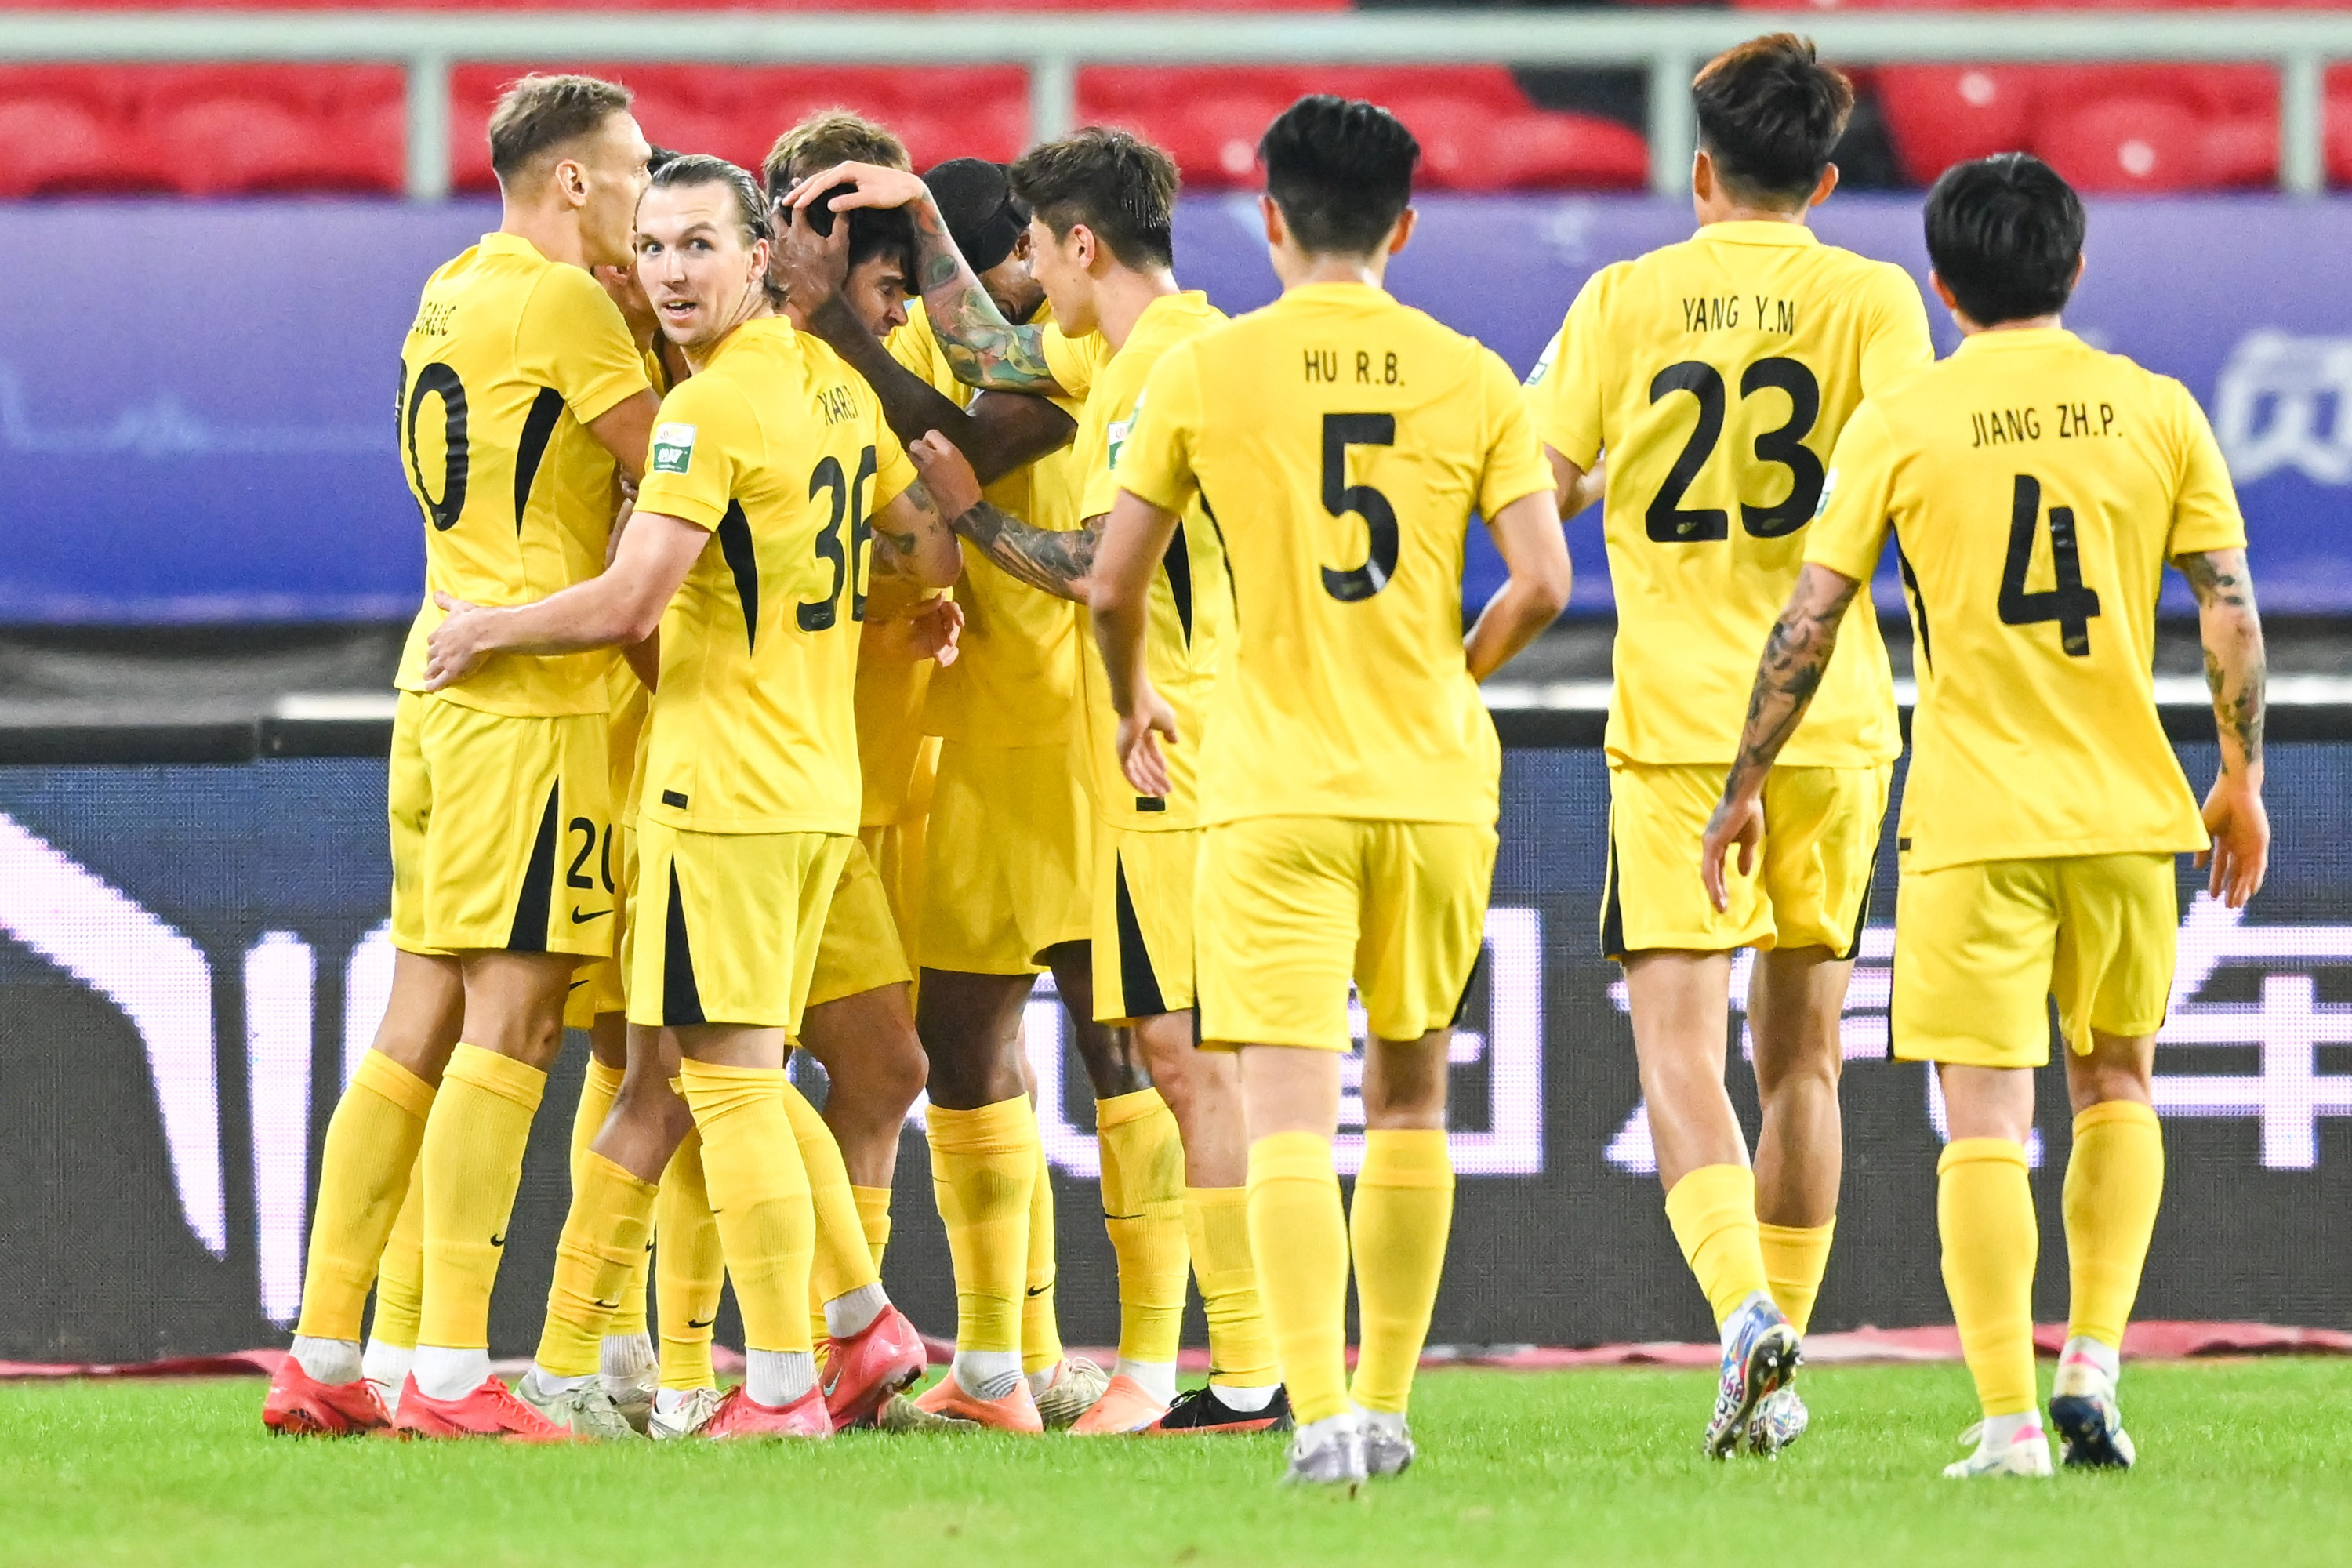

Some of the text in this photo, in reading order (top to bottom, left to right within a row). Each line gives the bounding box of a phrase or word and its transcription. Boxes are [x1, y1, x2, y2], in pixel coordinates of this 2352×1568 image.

[1303, 348, 1406, 386] HU R.B.
[1682, 295, 1740, 333] YANG
[395, 358, 470, 532] 0
[1321, 412, 1399, 602] 5
[1644, 357, 1825, 543] 23
[1971, 402, 2122, 448] JIANG ZH.P.
[1998, 474, 2100, 658] 4
